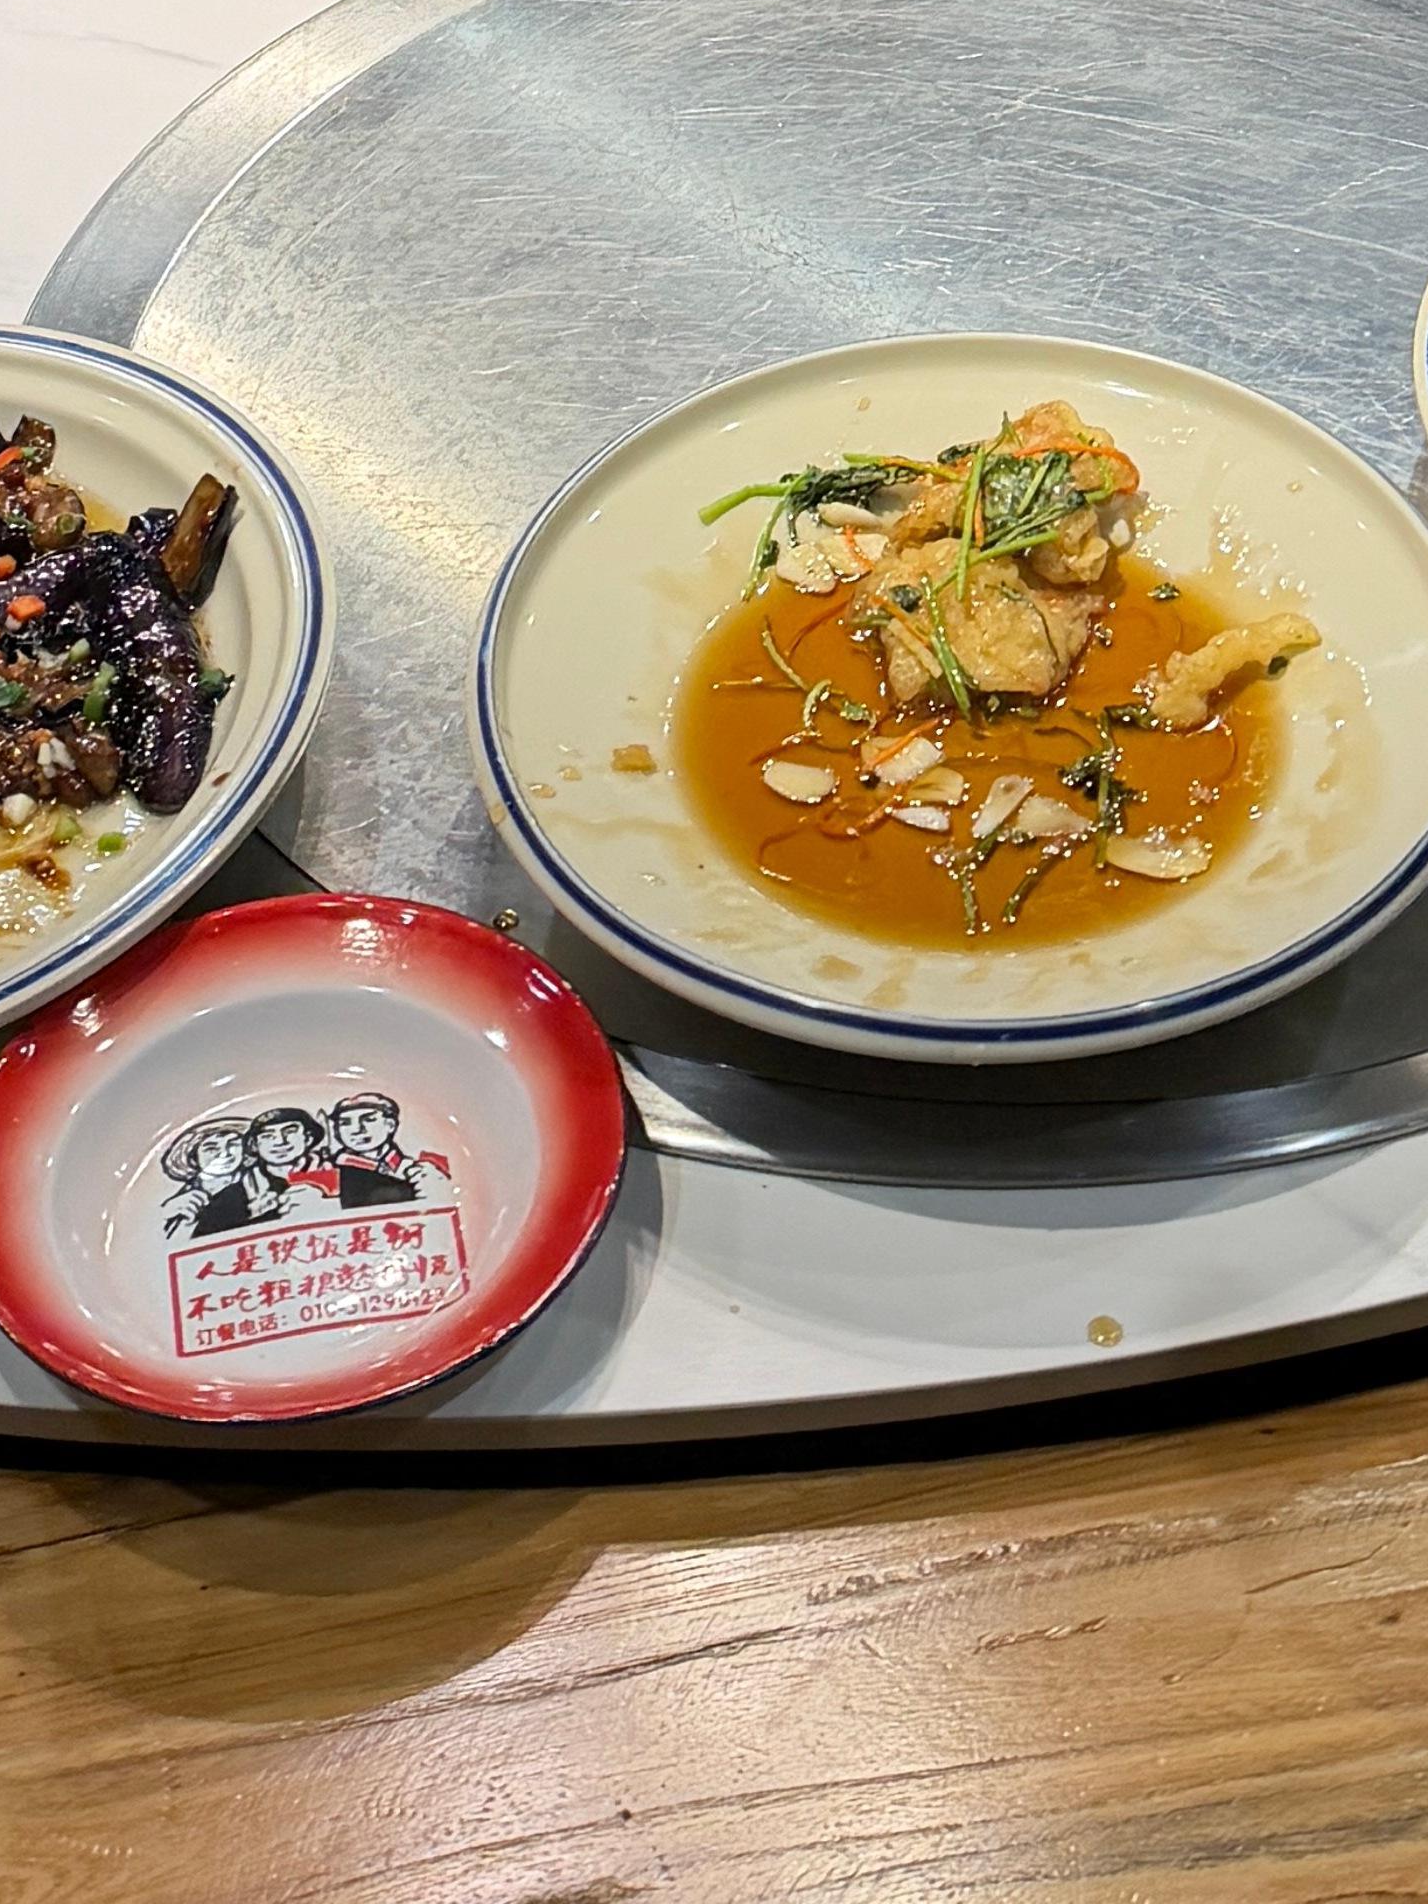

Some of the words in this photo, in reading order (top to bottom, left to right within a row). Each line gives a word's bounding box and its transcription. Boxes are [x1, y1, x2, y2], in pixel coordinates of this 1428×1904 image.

[187, 1253, 455, 1321] 不吃粗粮憋慌
